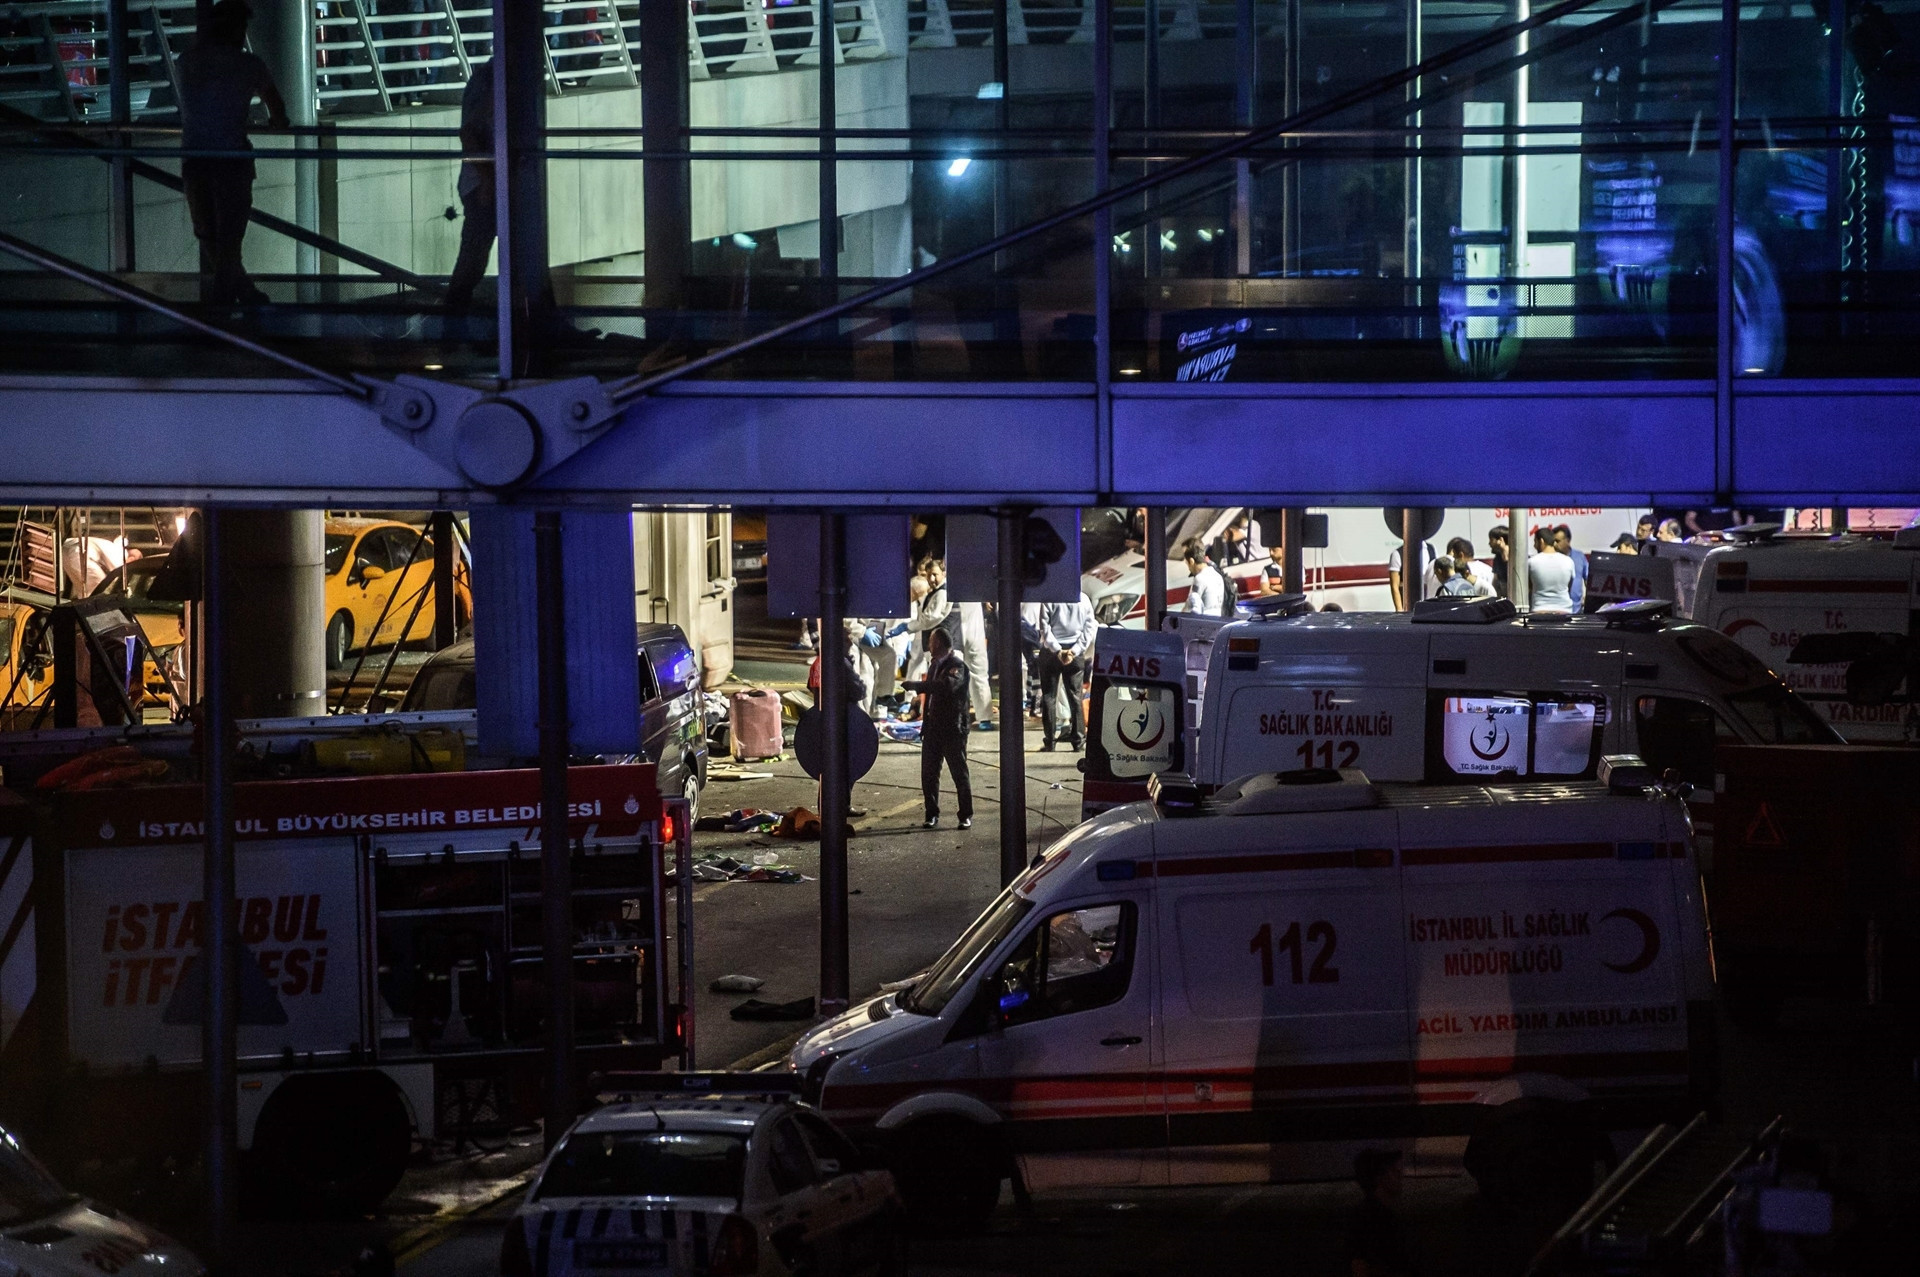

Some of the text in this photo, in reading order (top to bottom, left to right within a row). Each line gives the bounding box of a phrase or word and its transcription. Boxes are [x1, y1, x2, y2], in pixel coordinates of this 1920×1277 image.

[1586, 574, 1652, 597] LANS
[1824, 610, 1847, 629] T.C.
[1094, 653, 1161, 678] LANS
[1313, 690, 1340, 711] T.C.
[1828, 703, 1900, 722] YARDIM
[1260, 709, 1393, 736] SAĞLIK BAKANLIĞI
[1297, 740, 1360, 769] 112
[139, 820, 268, 838] İSTAUL
[453, 799, 602, 824] BELEDİESİ
[1410, 907, 1590, 941] İSTANBUL İL SAĞLIK
[1249, 919, 1340, 987] 112
[1444, 943, 1562, 976] MÜDÜRLÜĞÜ
[1416, 1005, 1678, 1035] ACİL YARDIM AMBULANSI
